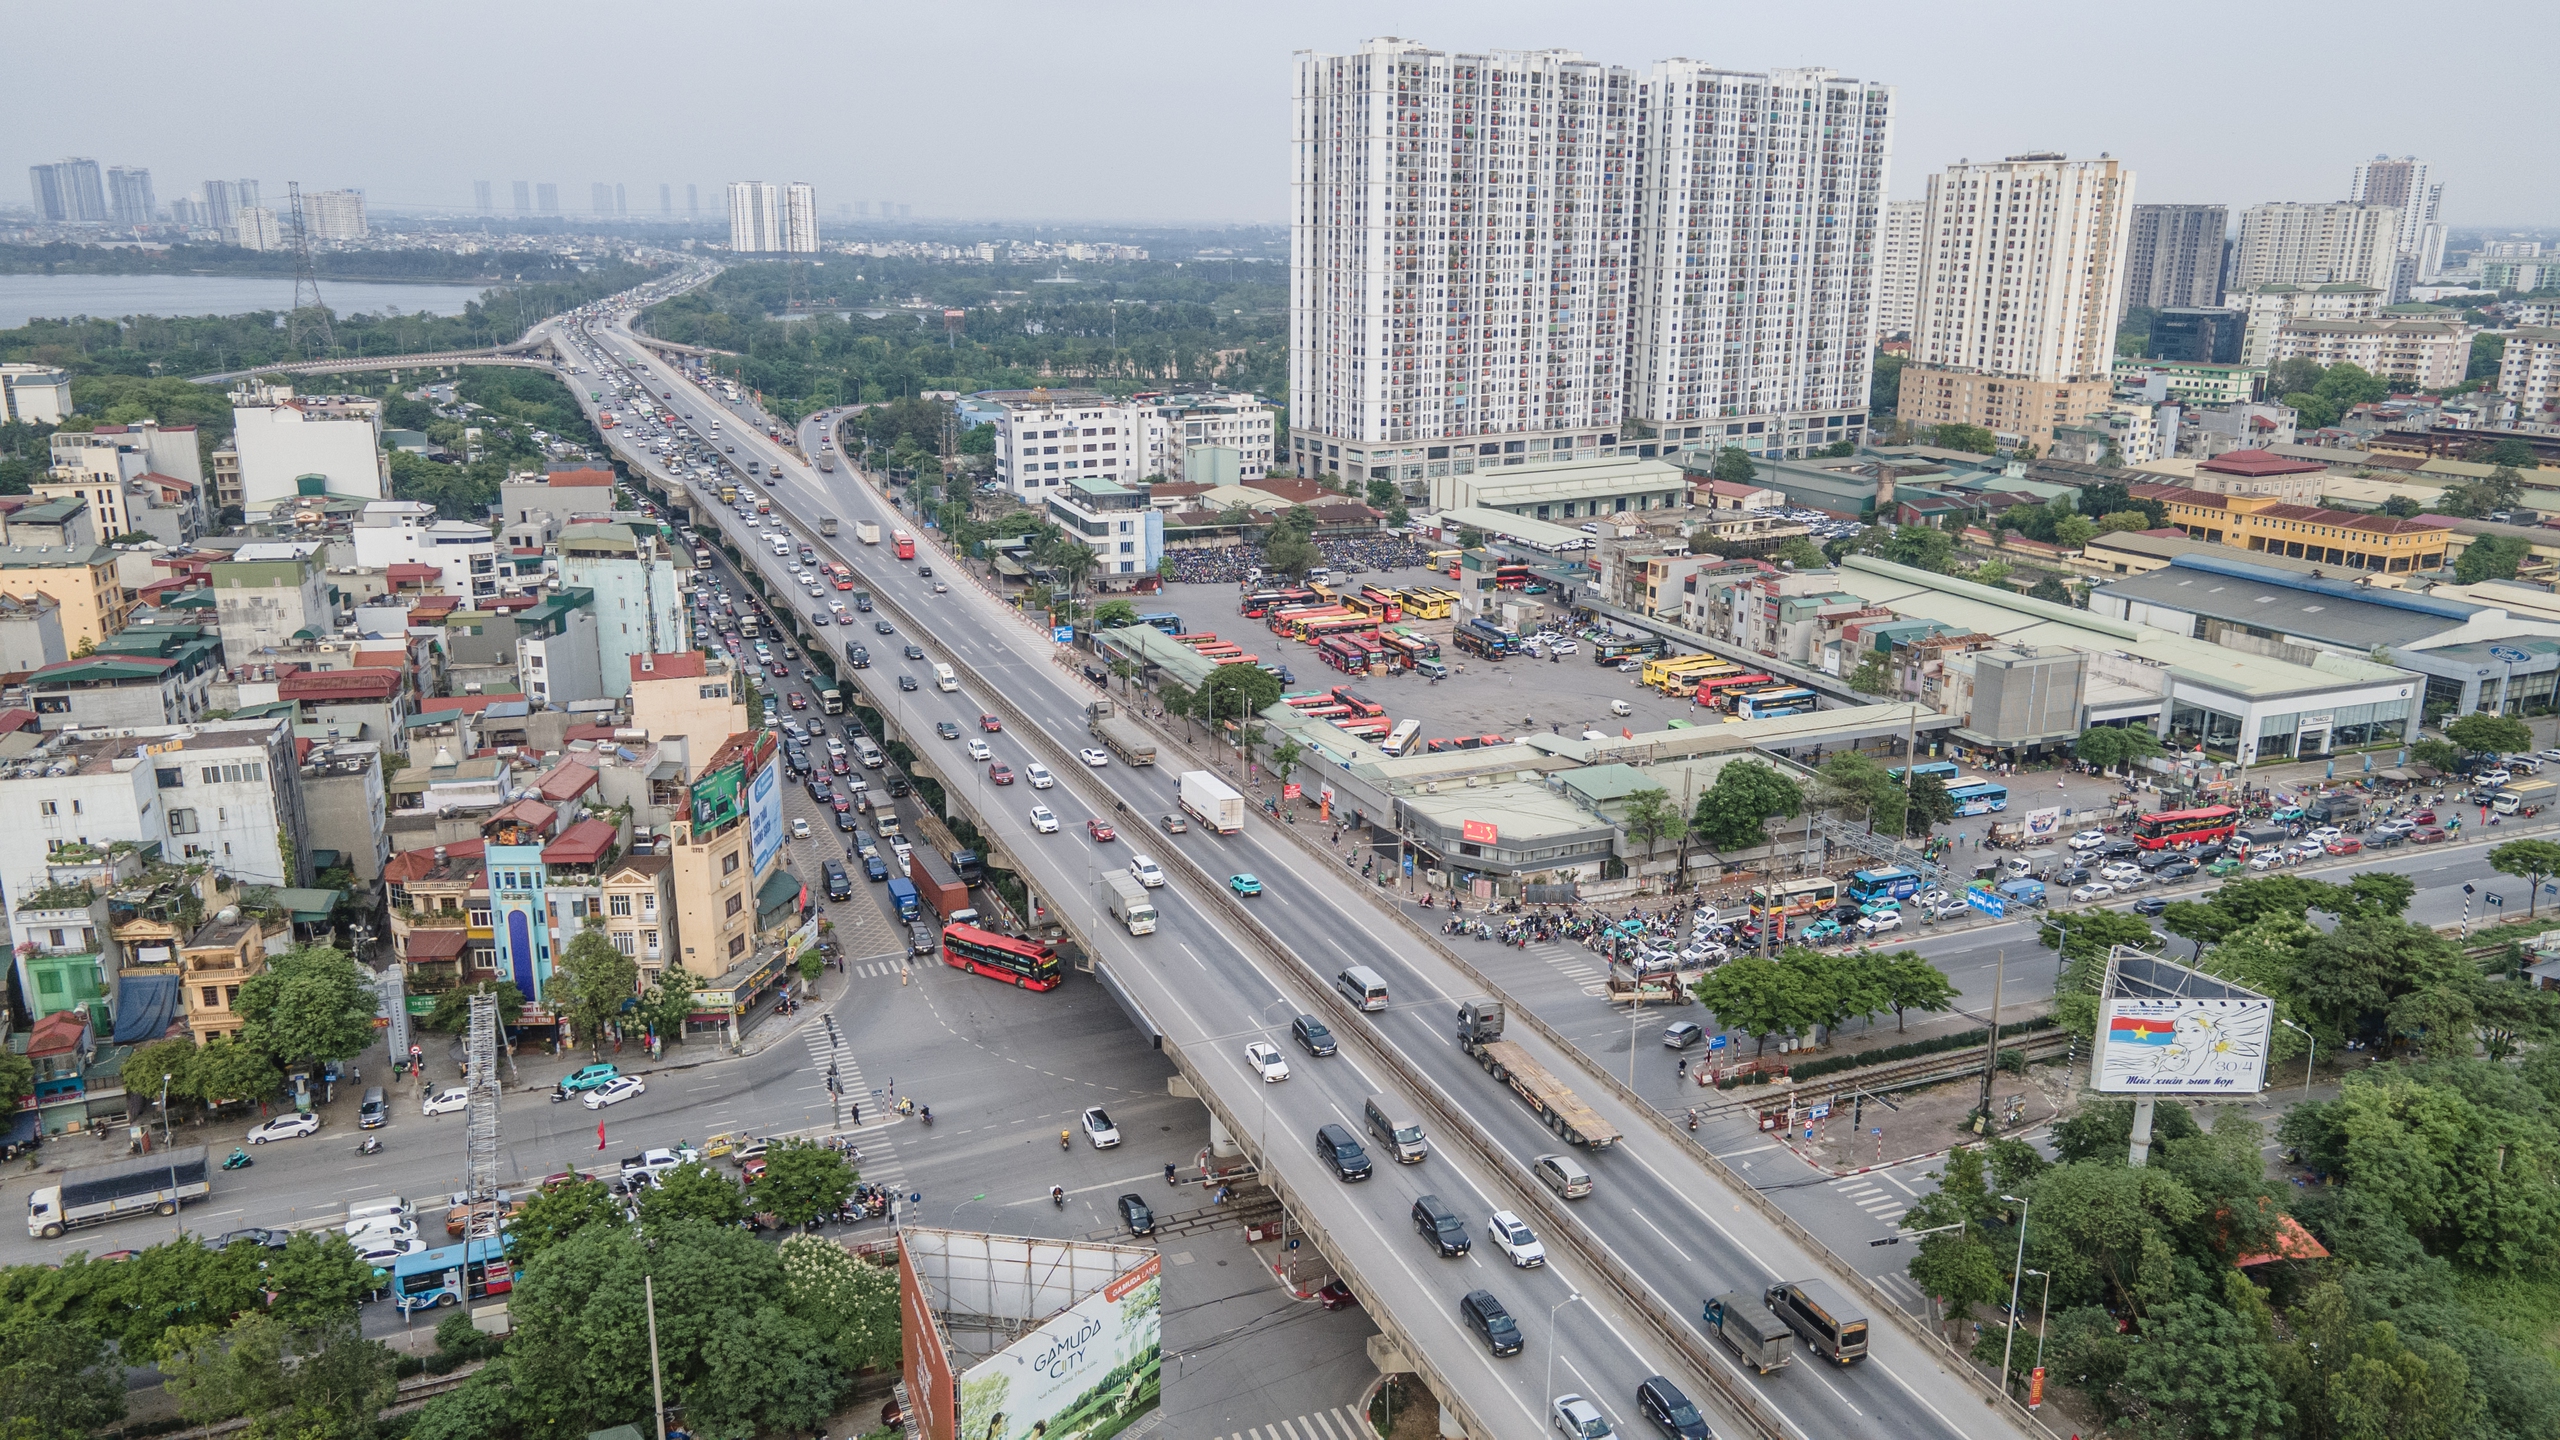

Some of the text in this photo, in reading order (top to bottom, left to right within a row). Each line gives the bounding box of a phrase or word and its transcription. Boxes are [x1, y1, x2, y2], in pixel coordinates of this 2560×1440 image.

[2495, 648, 2520, 660] Ford
[2313, 715, 2330, 723] THACO
[2215, 1061, 2253, 1072] 30/4
[2125, 1075, 2151, 1085] Mùa
[2153, 1076, 2183, 1085] xuân
[2214, 1076, 2234, 1087] họp
[1112, 1263, 1158, 1297] GAMUDA LAND
[1034, 1319, 1102, 1372] GAMUDA
[1050, 1346, 1086, 1379] CITY
